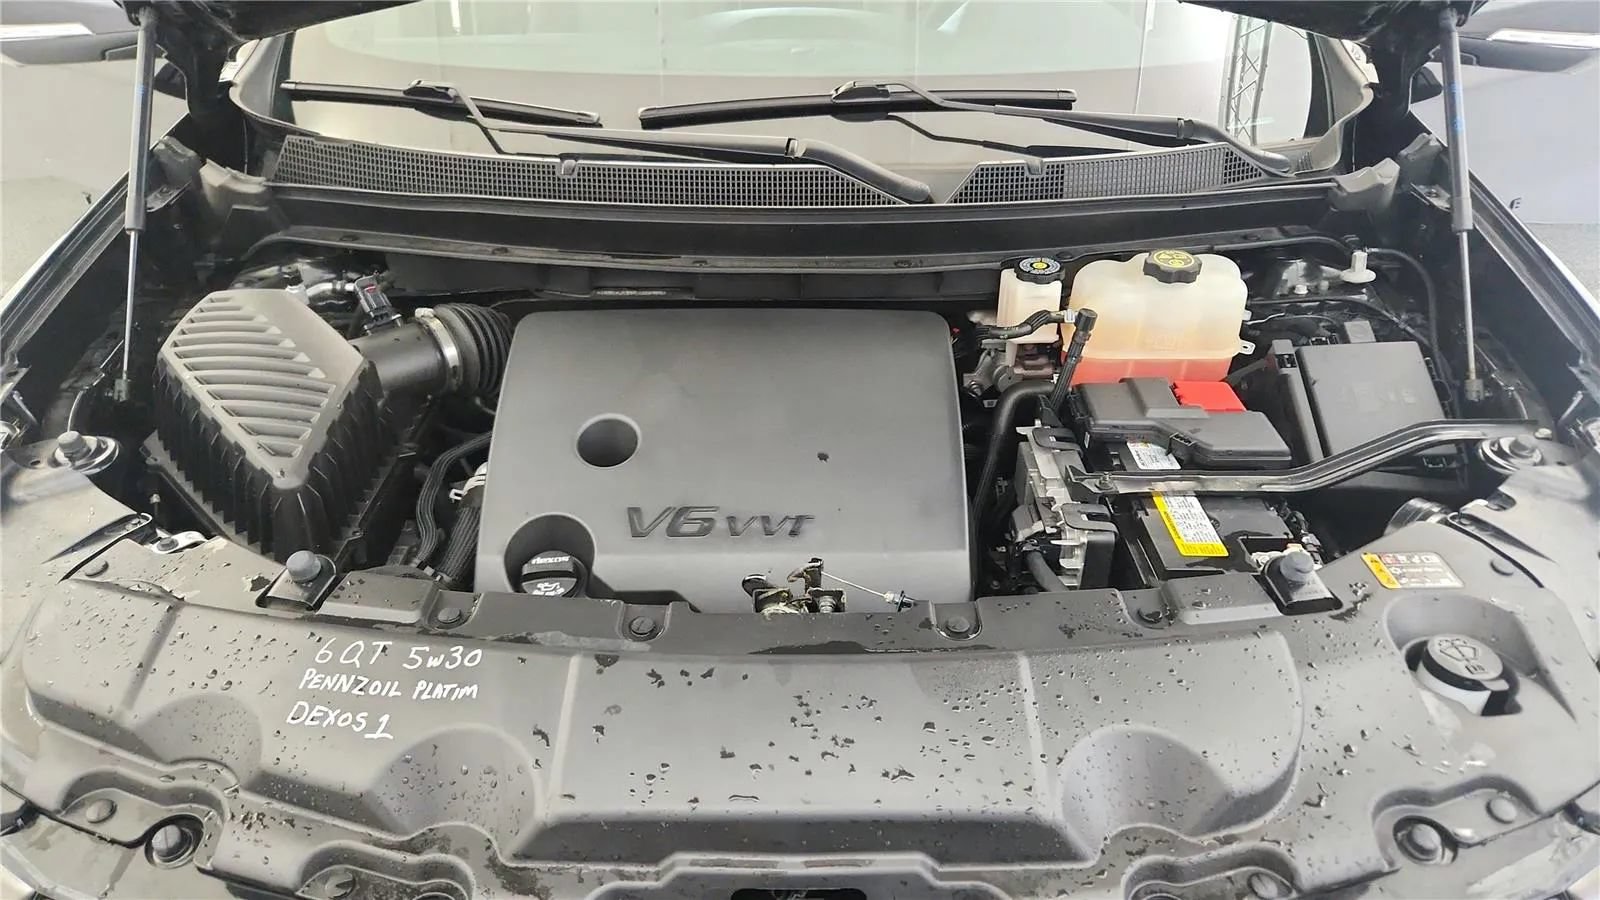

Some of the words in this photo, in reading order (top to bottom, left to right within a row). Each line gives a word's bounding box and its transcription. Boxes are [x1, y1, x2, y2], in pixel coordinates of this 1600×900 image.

[627, 506, 720, 538] V6
[726, 514, 815, 537] VVT
[298, 668, 402, 697] PENNZOIL
